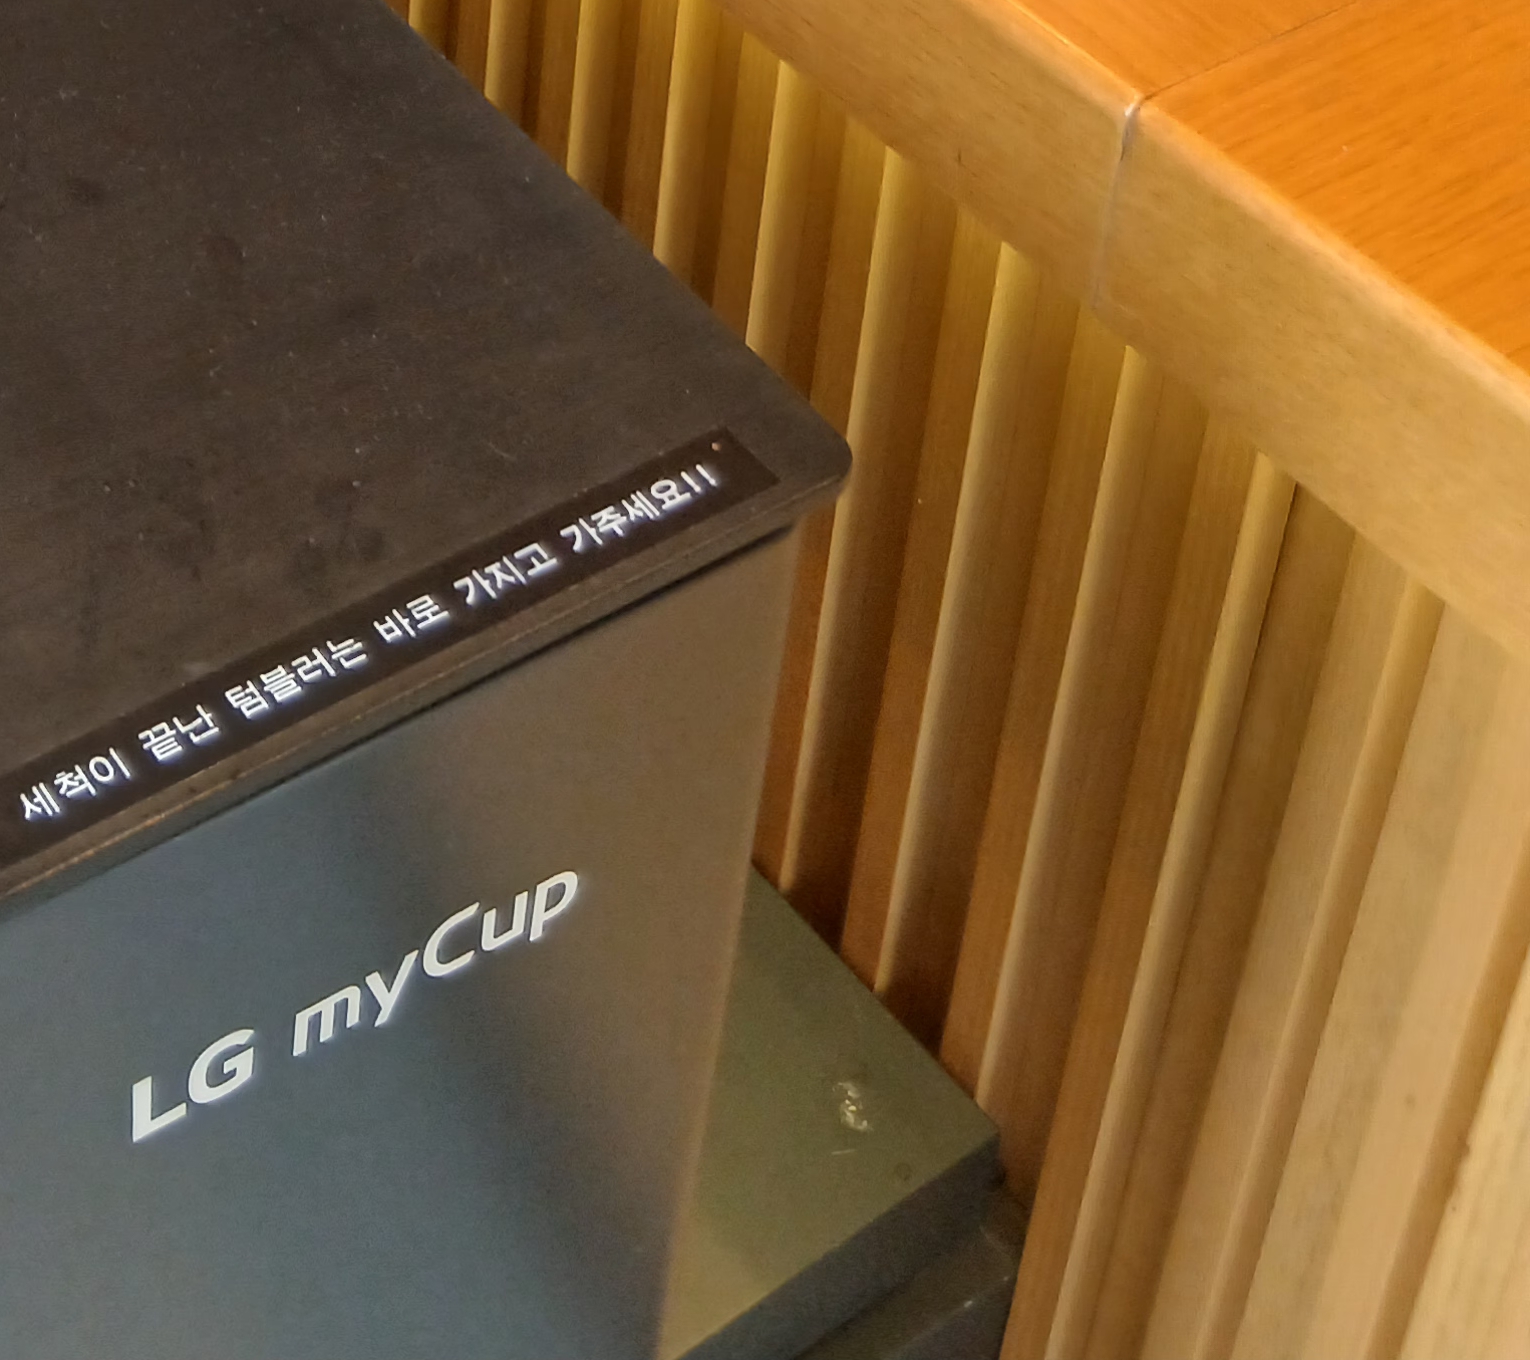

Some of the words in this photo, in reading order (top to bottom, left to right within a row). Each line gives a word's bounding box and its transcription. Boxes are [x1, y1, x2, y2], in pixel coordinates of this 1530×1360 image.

[18, 746, 132, 824] 세척이
[138, 704, 220, 766] 끝난
[225, 635, 368, 720] 텀블러는
[373, 593, 451, 648] 바로
[452, 543, 558, 606] 가지고
[132, 1028, 256, 1144] LG
[293, 870, 579, 1057] myCup
